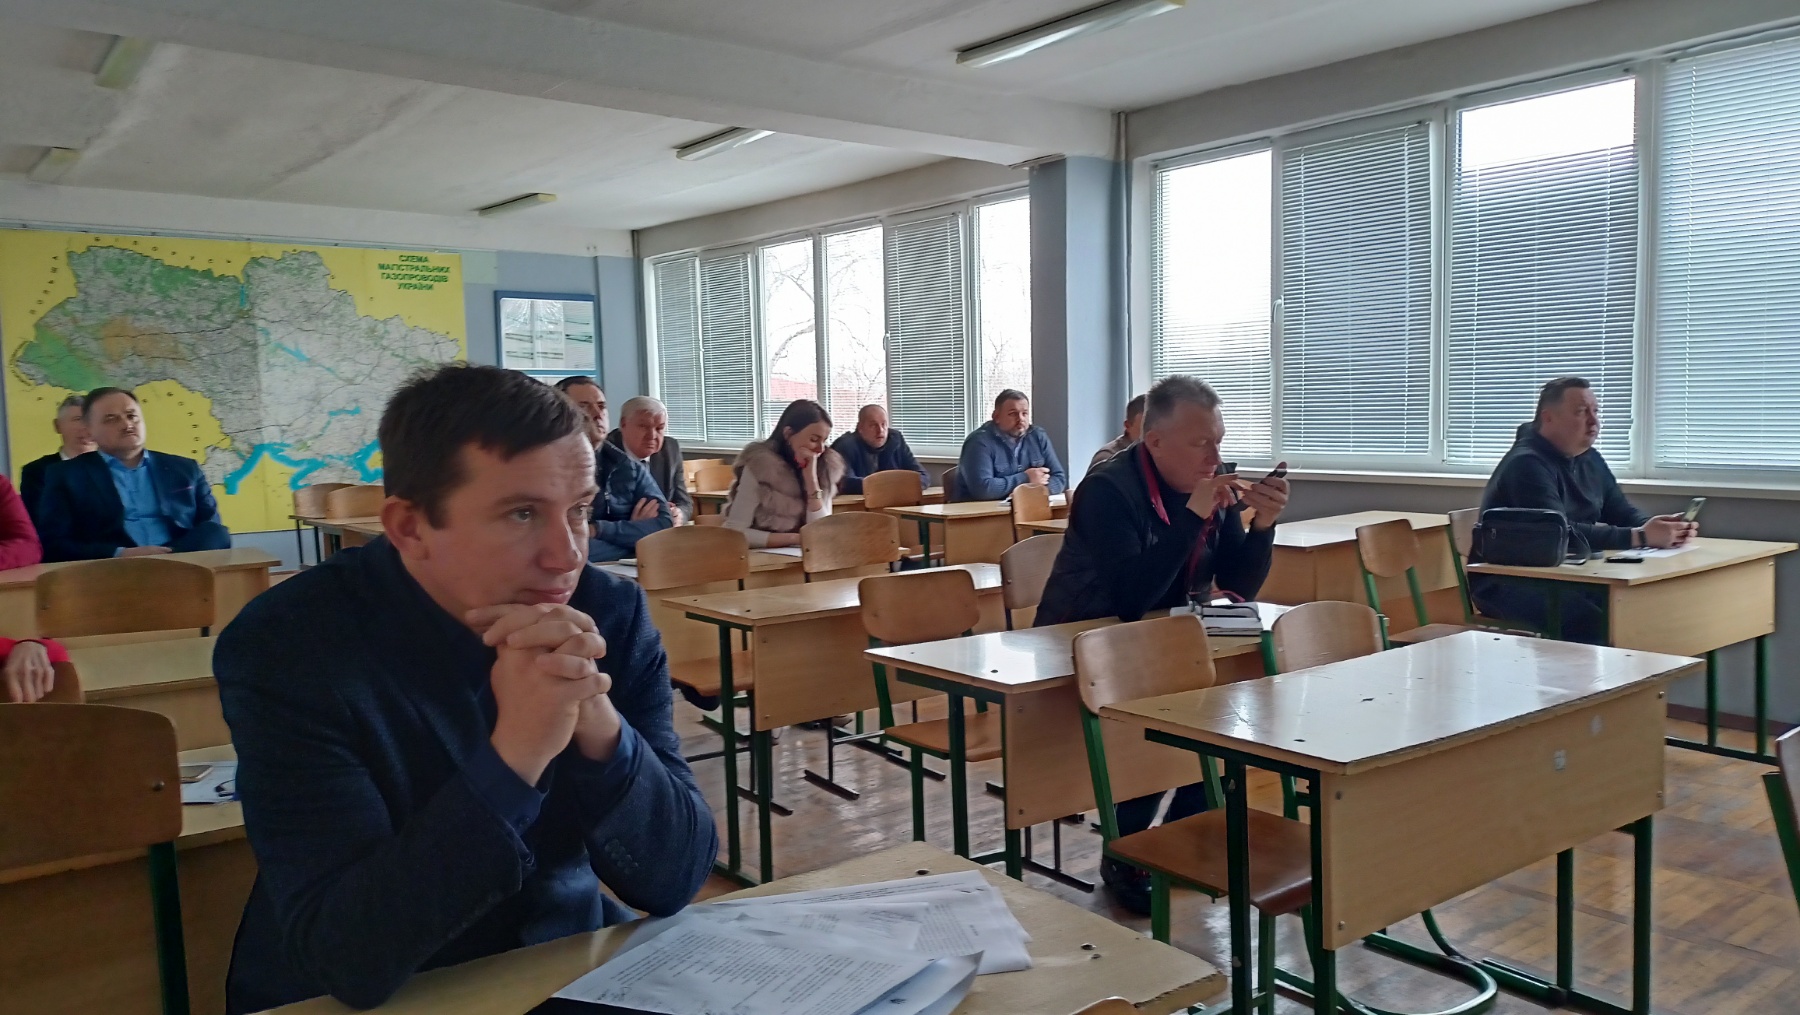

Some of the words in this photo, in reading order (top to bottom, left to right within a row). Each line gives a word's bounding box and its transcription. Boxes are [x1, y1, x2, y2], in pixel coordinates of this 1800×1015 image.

[399, 254, 429, 262] СХЕМА
[378, 263, 451, 273] МАГІСТРАЛЬНИХ
[381, 272, 449, 283] ГАЗОПРОВОДІВ
[397, 282, 434, 291] УКРАЇНИ
